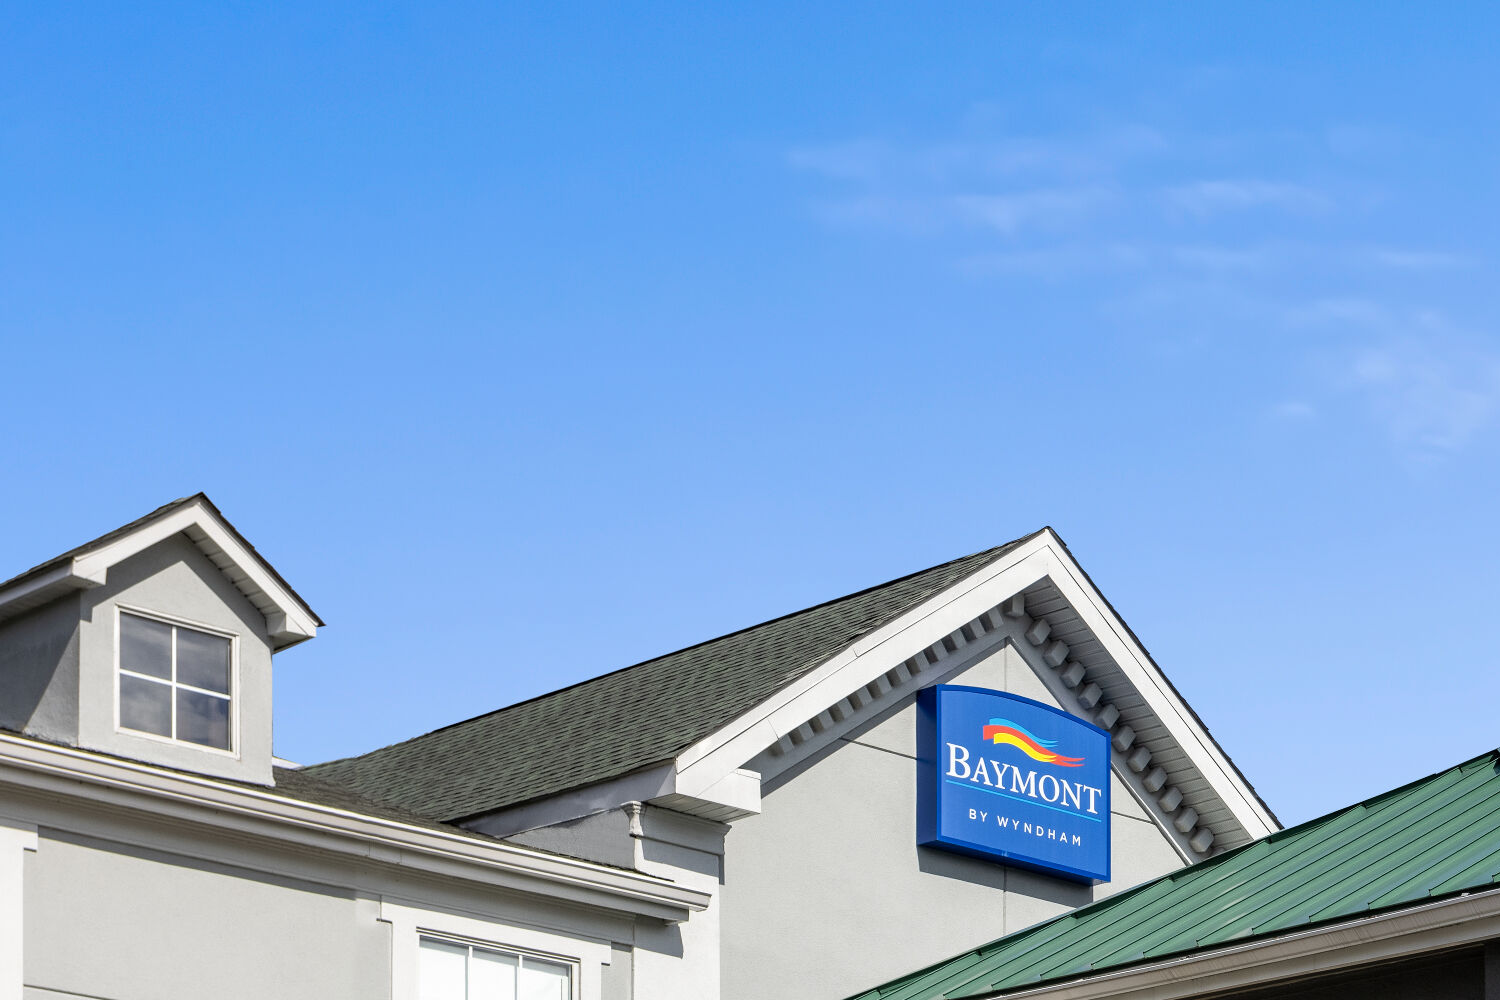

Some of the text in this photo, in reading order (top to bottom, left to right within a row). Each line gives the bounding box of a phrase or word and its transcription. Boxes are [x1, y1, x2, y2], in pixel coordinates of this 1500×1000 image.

[946, 742, 1102, 814] BAYMONT
[969, 808, 1081, 846] BY WYNDHAM
